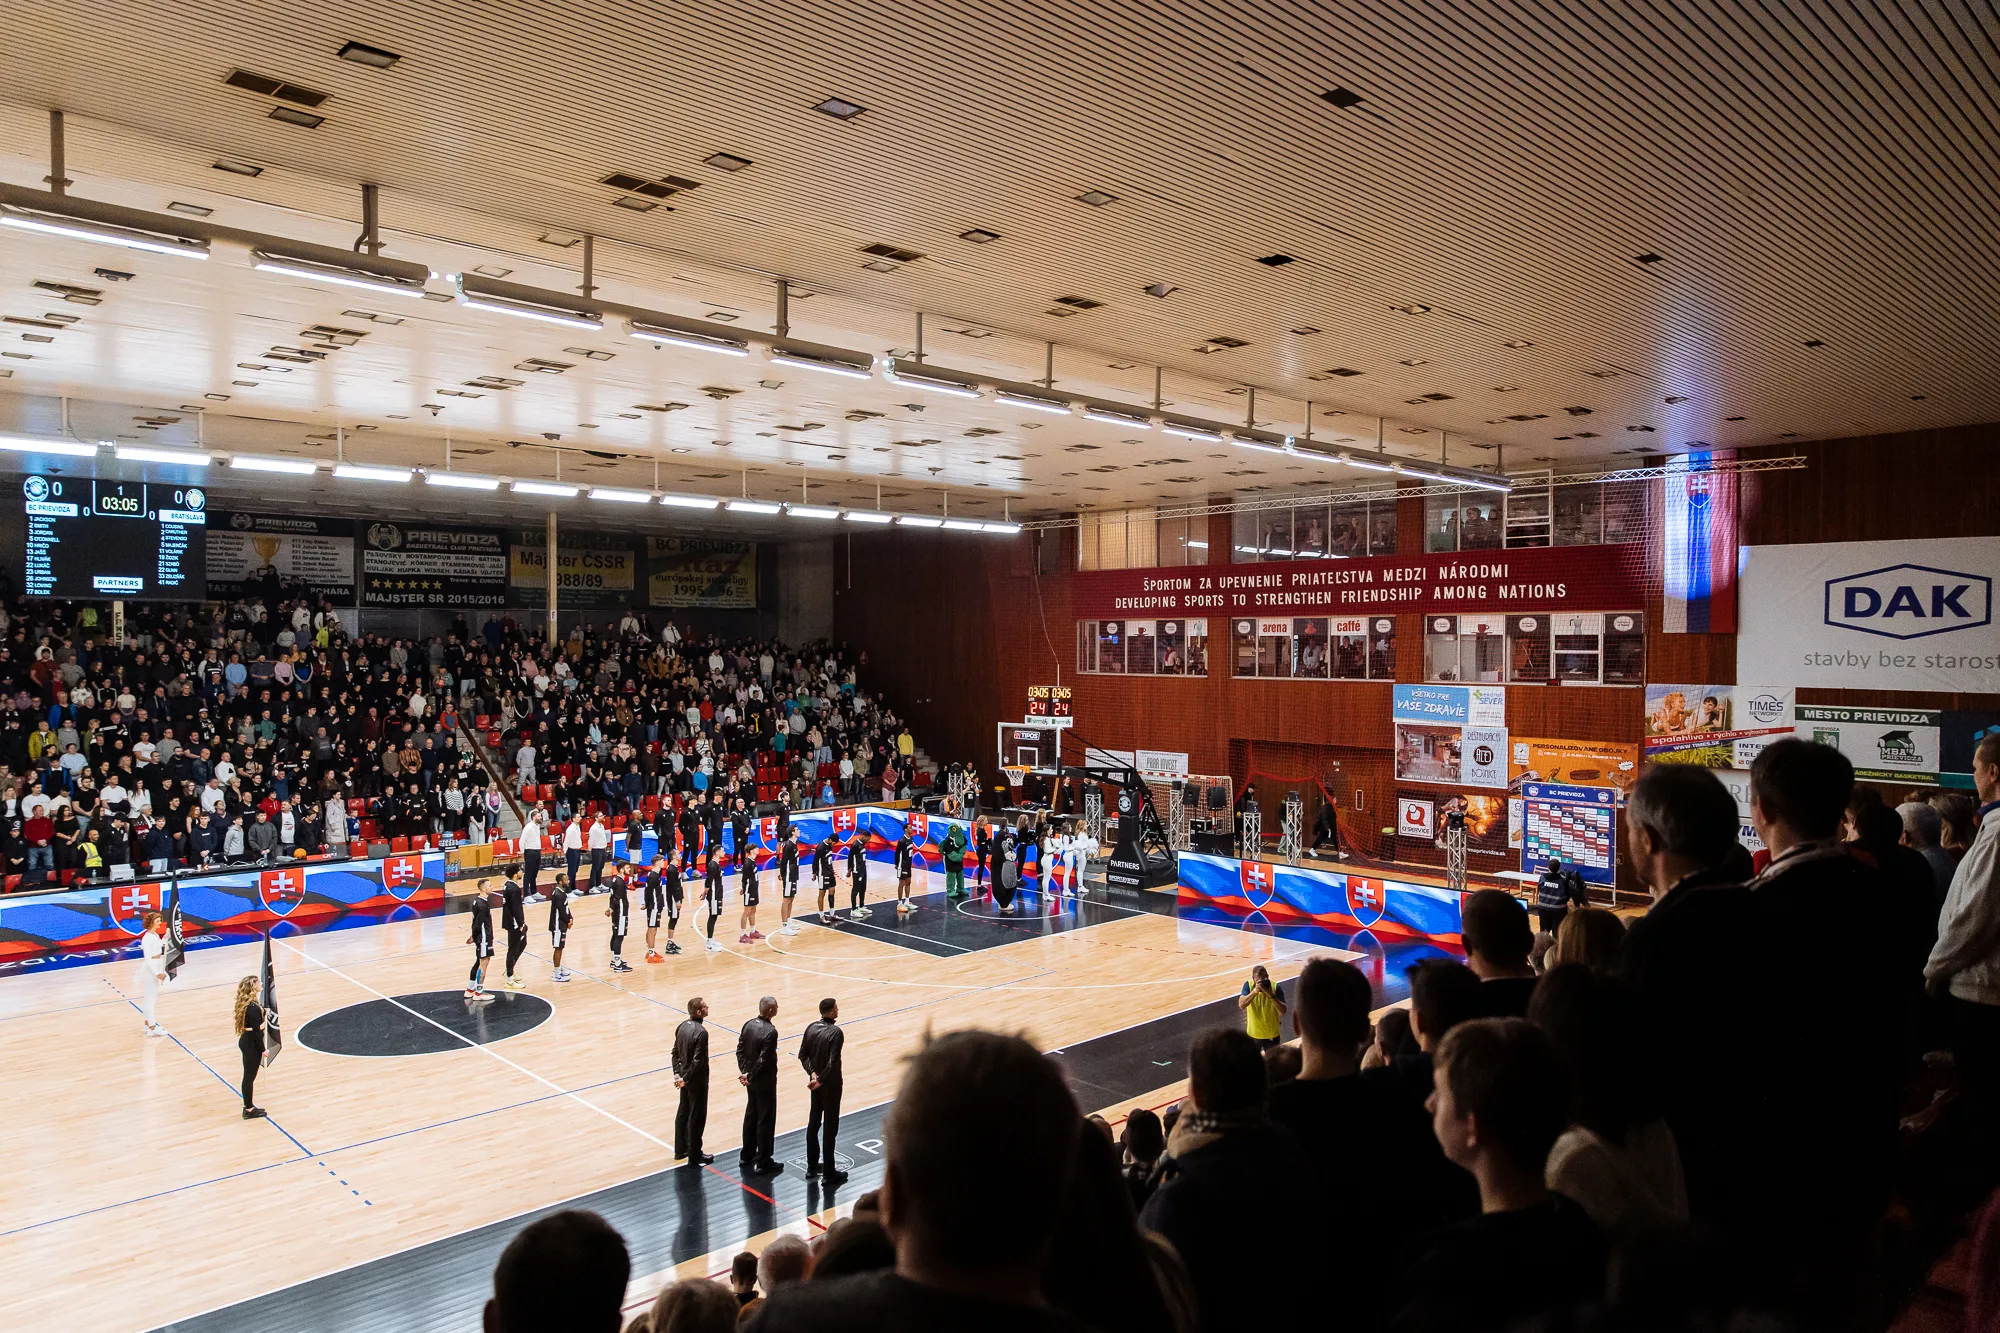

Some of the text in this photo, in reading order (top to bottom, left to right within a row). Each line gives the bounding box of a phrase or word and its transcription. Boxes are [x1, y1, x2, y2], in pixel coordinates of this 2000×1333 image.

[52, 482, 62, 496] 0
[117, 486, 123, 496] 1
[174, 490, 183, 504] 0
[38, 505, 71, 513] PRIEVIDZA
[102, 496, 138, 512] 03:05
[83, 506, 91, 516] 0
[148, 510, 156, 520] 0
[170, 512, 204, 520] BRATISLAVA
[255, 518, 318, 529] PRIEVIDZA
[406, 531, 500, 545] PRIEVIDZA
[656, 538, 750, 554] BC PRIEVIDZA
[520, 550, 625, 570] Majter ČSSR
[556, 573, 603, 587] 988/89
[655, 573, 704, 584] európskej
[1143, 560, 1509, 592] ŠPORTOM ZA UPEVNENIE PRIATEĽSTVA MEDZI NÁRODMI
[97, 579, 139, 587] PARTNERS
[366, 592, 505, 604] MAJSTER SR 2015/2016
[1115, 583, 1567, 609] DEVELOPING SPORTS TO STRENGTHEN FRIENDSHIP AMONG NATIONS
[1844, 585, 1972, 618] DAK
[1262, 623, 1288, 633] arena
[1336, 620, 1361, 632] caffé
[1804, 650, 1871, 669] stavby
[1879, 651, 1916, 668] bez
[1028, 687, 1049, 698] 03:05
[1051, 688, 1072, 699] 03:05
[1411, 688, 1450, 701] VŠETKO PRE
[1397, 697, 1422, 711] VAŠE
[1479, 697, 1503, 705] SEVER
[1748, 700, 1784, 712] TIMES
[1030, 701, 1046, 715] 24
[1054, 703, 1068, 715] 24
[1804, 709, 1930, 724] MESTO PRIEVIDZA
[1651, 734, 1704, 745] spoľahlivo
[1713, 731, 1737, 739] rýchlo
[1881, 747, 1907, 755] MBA
[1110, 860, 1140, 871] PARTNERS
